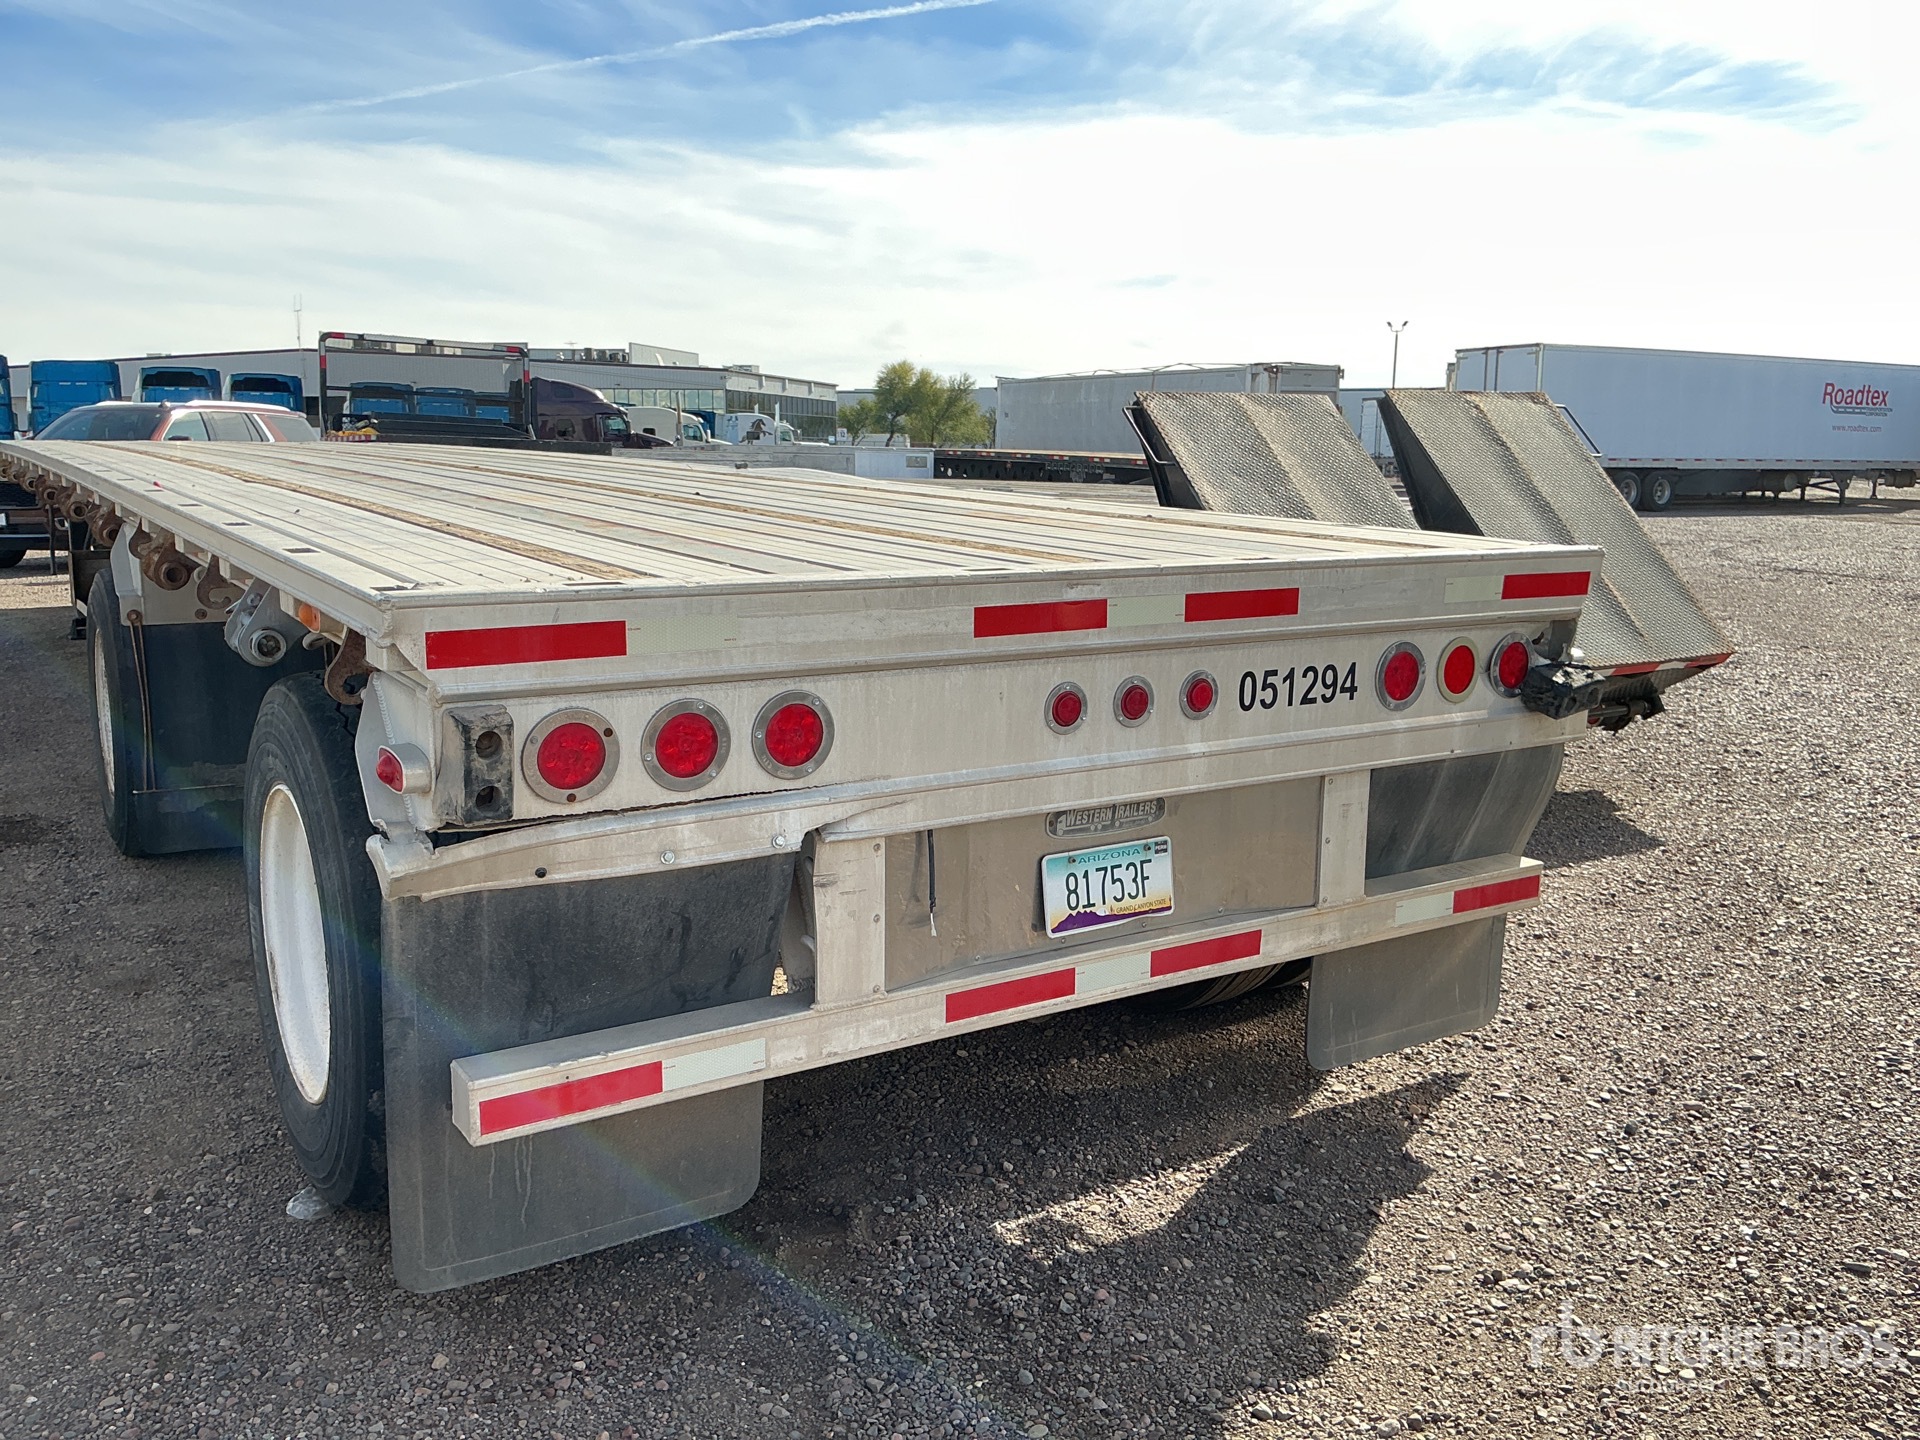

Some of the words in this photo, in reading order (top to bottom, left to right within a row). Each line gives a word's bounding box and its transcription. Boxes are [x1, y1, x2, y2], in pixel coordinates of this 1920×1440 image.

[1822, 382, 1889, 407] Roadtex
[1831, 424, 1882, 433] www.roadtex.com
[1238, 661, 1358, 712] 051294
[1066, 807, 1113, 827] WESTERN
[1115, 801, 1157, 819] TRAILERS
[1078, 848, 1141, 864] ARIZONA
[1065, 858, 1152, 911] 81753F
[1116, 904, 1134, 913] GRAND
[1134, 901, 1153, 911] CANYON
[1154, 898, 1166, 906] STATE
